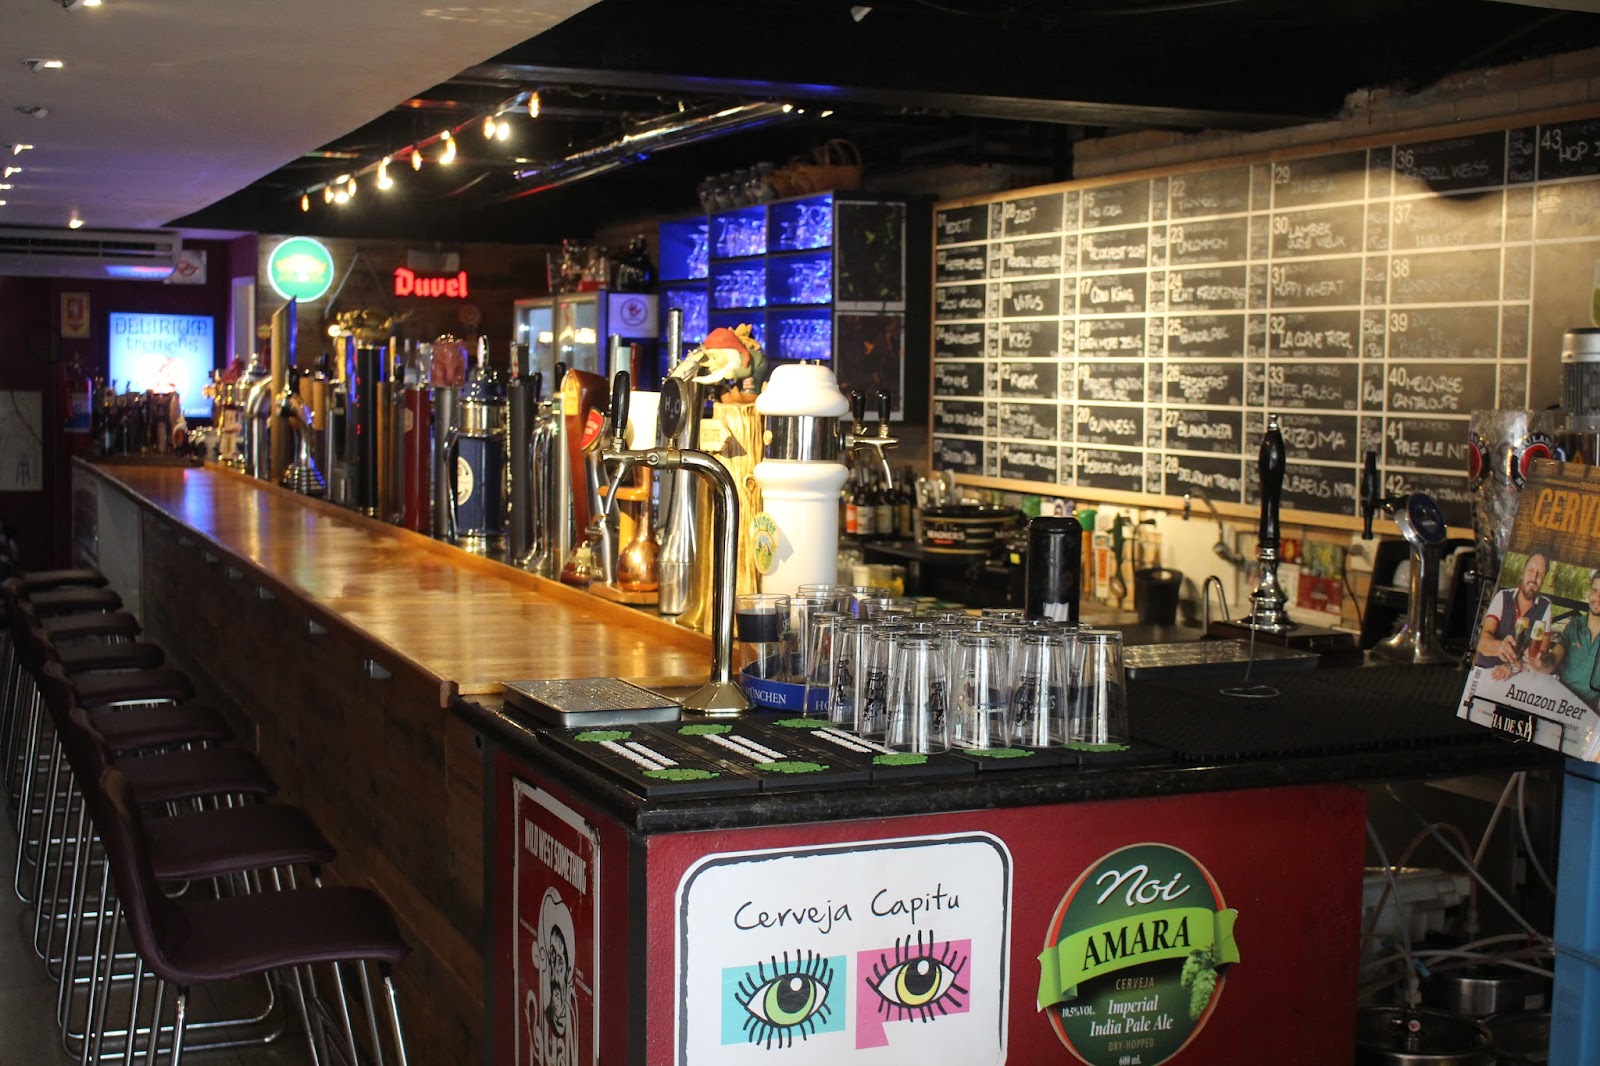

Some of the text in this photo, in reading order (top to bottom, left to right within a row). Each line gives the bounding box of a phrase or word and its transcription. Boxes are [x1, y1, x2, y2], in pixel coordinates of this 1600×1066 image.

[1541, 129, 1562, 151] 43
[1396, 150, 1415, 170] 36
[1559, 141, 1588, 163] HOP
[1275, 166, 1290, 184] 29
[1172, 180, 1186, 197] 22
[1084, 192, 1096, 208] 15
[1394, 204, 1413, 224] 37
[1273, 216, 1288, 234] 30
[1170, 226, 1185, 244] 23
[1271, 267, 1286, 285] 31
[1392, 258, 1410, 279] 38
[394, 267, 468, 299] Duvel
[1081, 278, 1093, 294] 17
[1169, 273, 1184, 290] 24
[115, 316, 209, 337] DELIRIUM
[1168, 318, 1182, 336] 25
[1270, 316, 1286, 335] 32
[1390, 313, 1409, 333] 39
[1167, 365, 1181, 383] 26
[1269, 365, 1285, 384] 33
[1388, 367, 1408, 388] 40
[1078, 407, 1090, 424] 20
[1166, 410, 1180, 428] 27
[1283, 427, 1347, 452] RIZOMA
[1387, 421, 1404, 442] 41
[1077, 449, 1089, 467] 21
[1423, 440, 1445, 457] ALE
[1166, 456, 1179, 474] 28
[1385, 475, 1403, 496] 42
[745, 687, 787, 705] MÜNCHEN
[1505, 683, 1588, 721] Amazon Beer
[1504, 717, 1516, 734] DE
[525, 817, 587, 896] WILD WEST SOMETHING
[1096, 864, 1191, 907] Noi
[734, 883, 960, 935] Cerveja Capitu
[1081, 916, 1191, 972] AMARA
[1115, 977, 1155, 992] CERVEJA
[1108, 994, 1159, 1018] Imperial
[1090, 1014, 1174, 1039] India Pale Ale
[1108, 1038, 1155, 1053] DRY-HOPPED
[1118, 1055, 1131, 1066] 600
